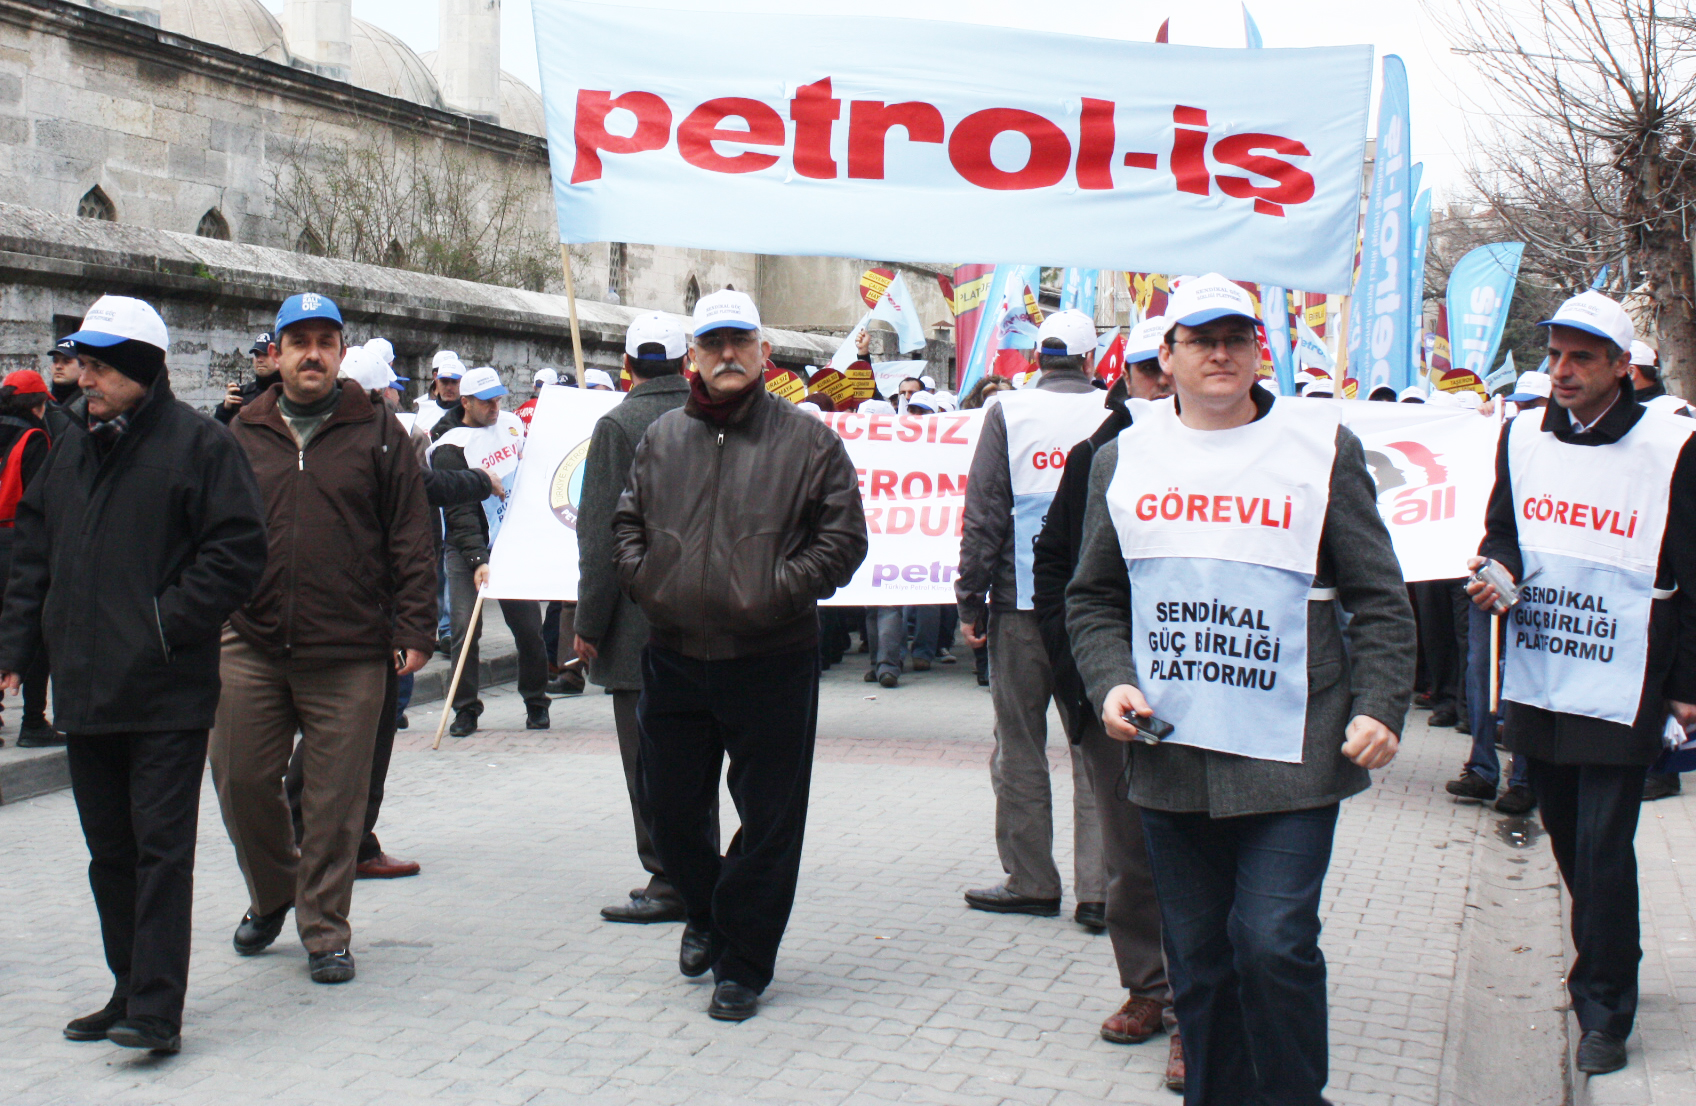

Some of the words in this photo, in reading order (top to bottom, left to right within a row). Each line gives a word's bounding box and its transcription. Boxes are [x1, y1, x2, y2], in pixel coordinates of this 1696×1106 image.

[570, 76, 1316, 217] petrol-iş
[766, 375, 788, 390] URALSIZ
[1135, 487, 1292, 529] GÖREVLİ
[1523, 494, 1638, 538] GÖREVLİ
[871, 561, 960, 587] petr
[1156, 598, 1270, 631] SENDİKAL
[1521, 586, 1608, 614] SENDİKAL
[1515, 607, 1541, 632] GÜÇ
[1543, 609, 1617, 640] BİRLİĞİ
[1148, 627, 1186, 657] GÜÇ
[1195, 627, 1280, 663] BİRLİĞİ
